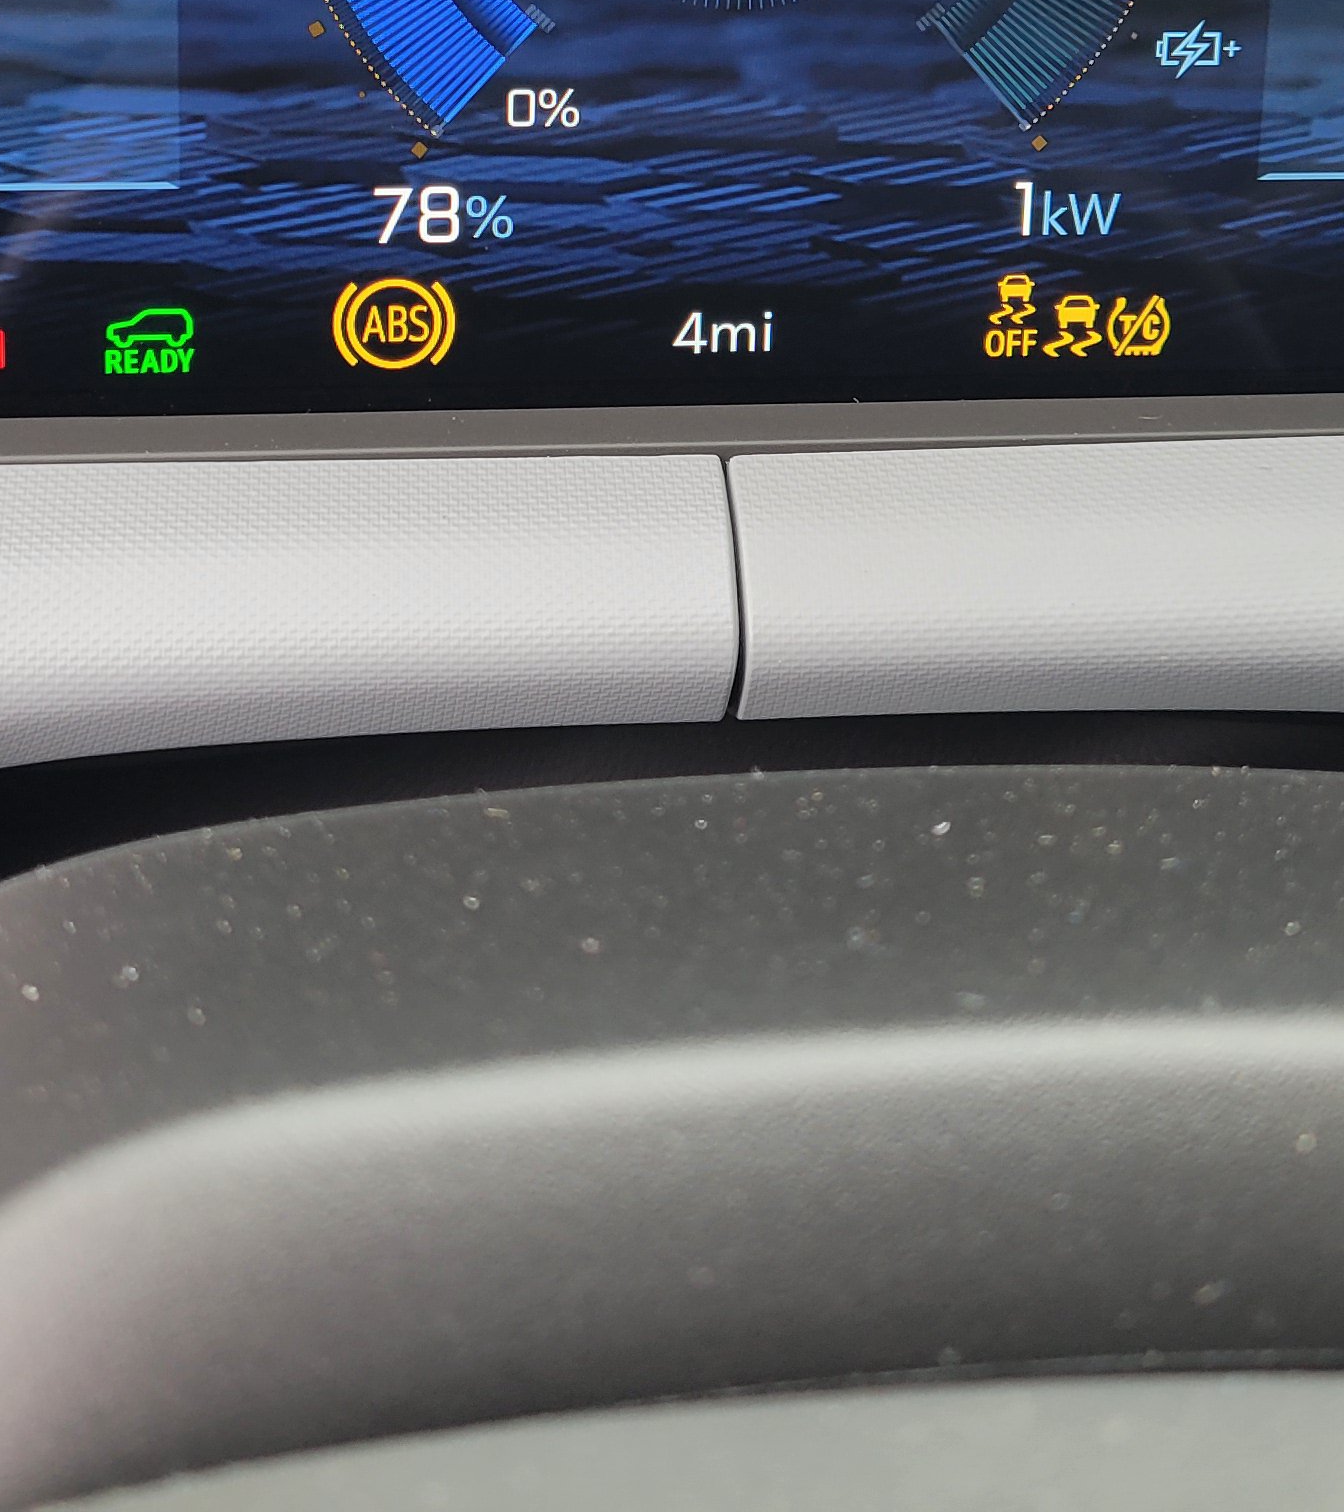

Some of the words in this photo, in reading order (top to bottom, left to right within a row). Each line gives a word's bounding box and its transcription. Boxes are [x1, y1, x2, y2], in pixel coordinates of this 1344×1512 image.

[507, 88, 580, 128] 0%
[372, 185, 514, 244] 78%
[1015, 181, 1122, 237] 1kW
[361, 304, 431, 343] ABS
[672, 311, 773, 354] 4mi
[984, 328, 1038, 358] OFF
[104, 347, 195, 375] READY
